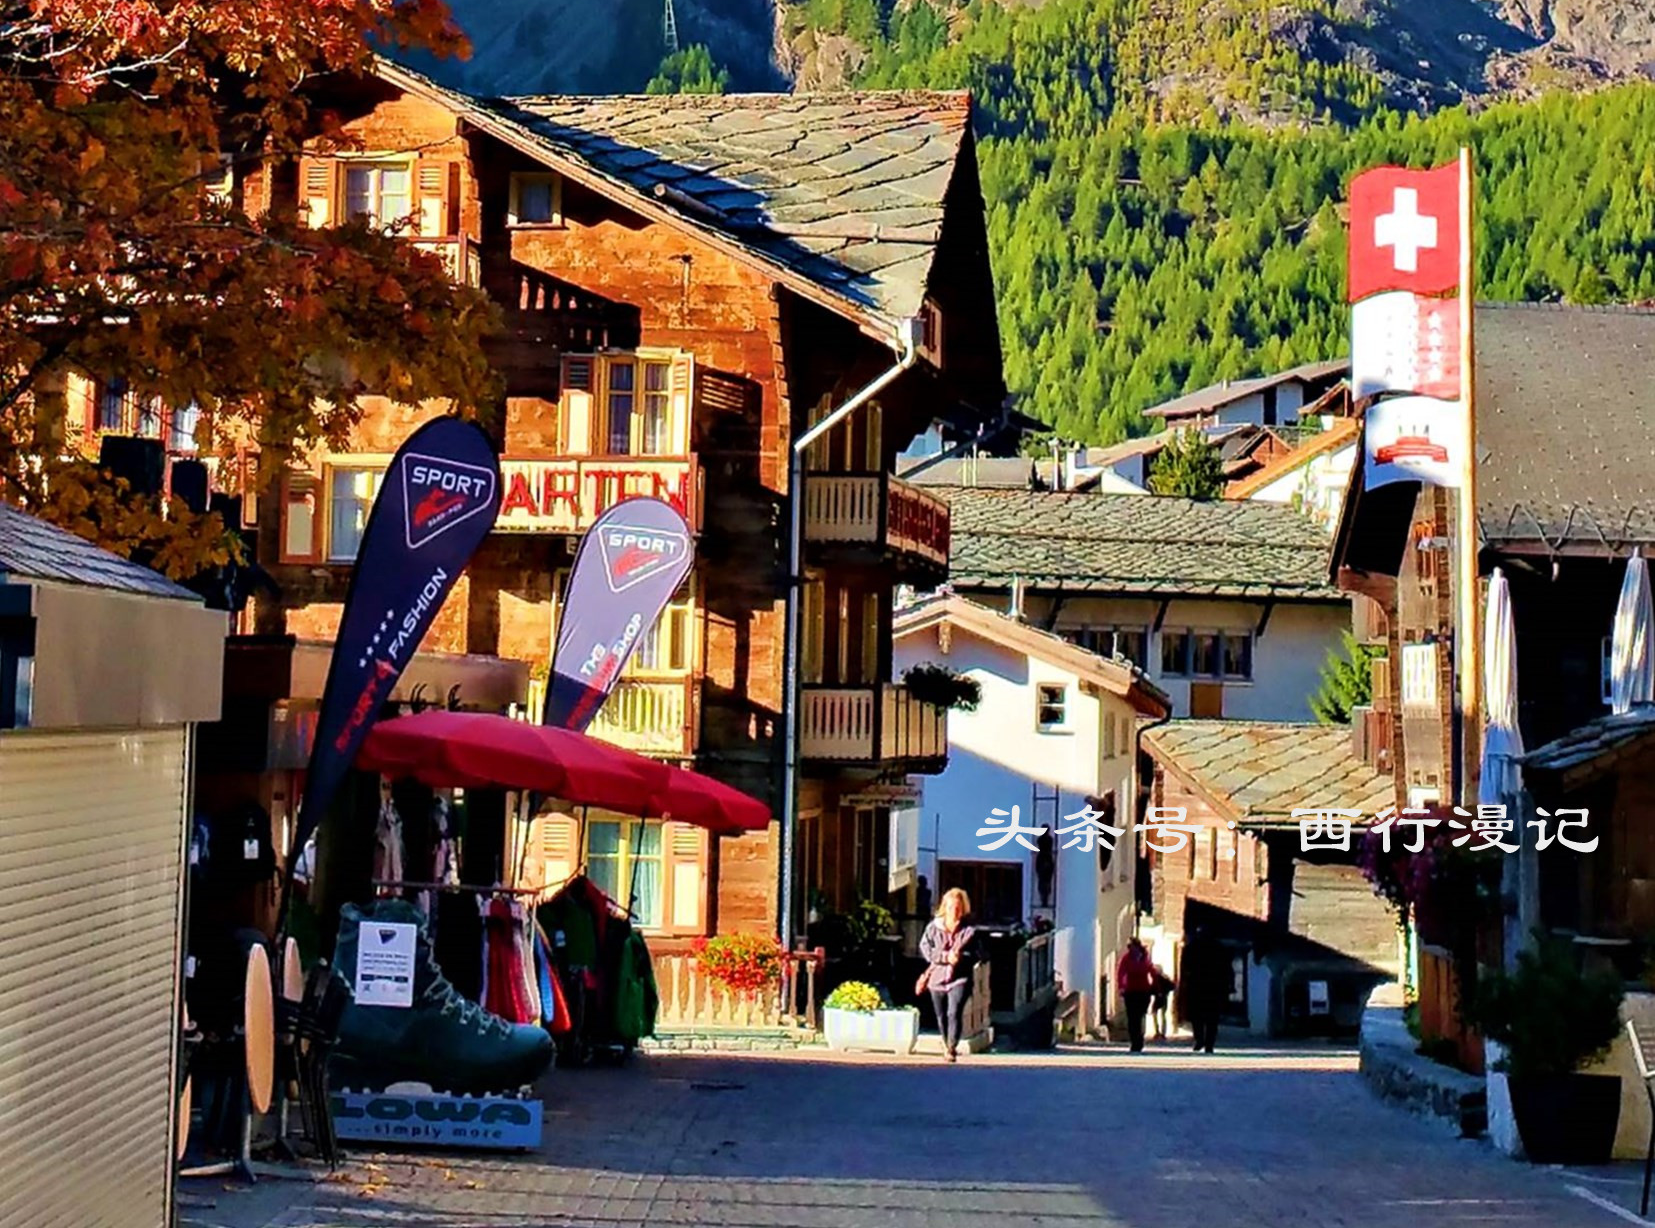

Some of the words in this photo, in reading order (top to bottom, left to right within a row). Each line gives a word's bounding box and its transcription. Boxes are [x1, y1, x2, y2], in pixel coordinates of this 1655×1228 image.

[411, 466, 487, 498] SPORT
[609, 533, 679, 554] SPORT
[388, 567, 448, 659] FASHION
[612, 613, 643, 658] SHOP
[331, 1097, 531, 1126] LOWA
[453, 1127, 503, 1139] more
